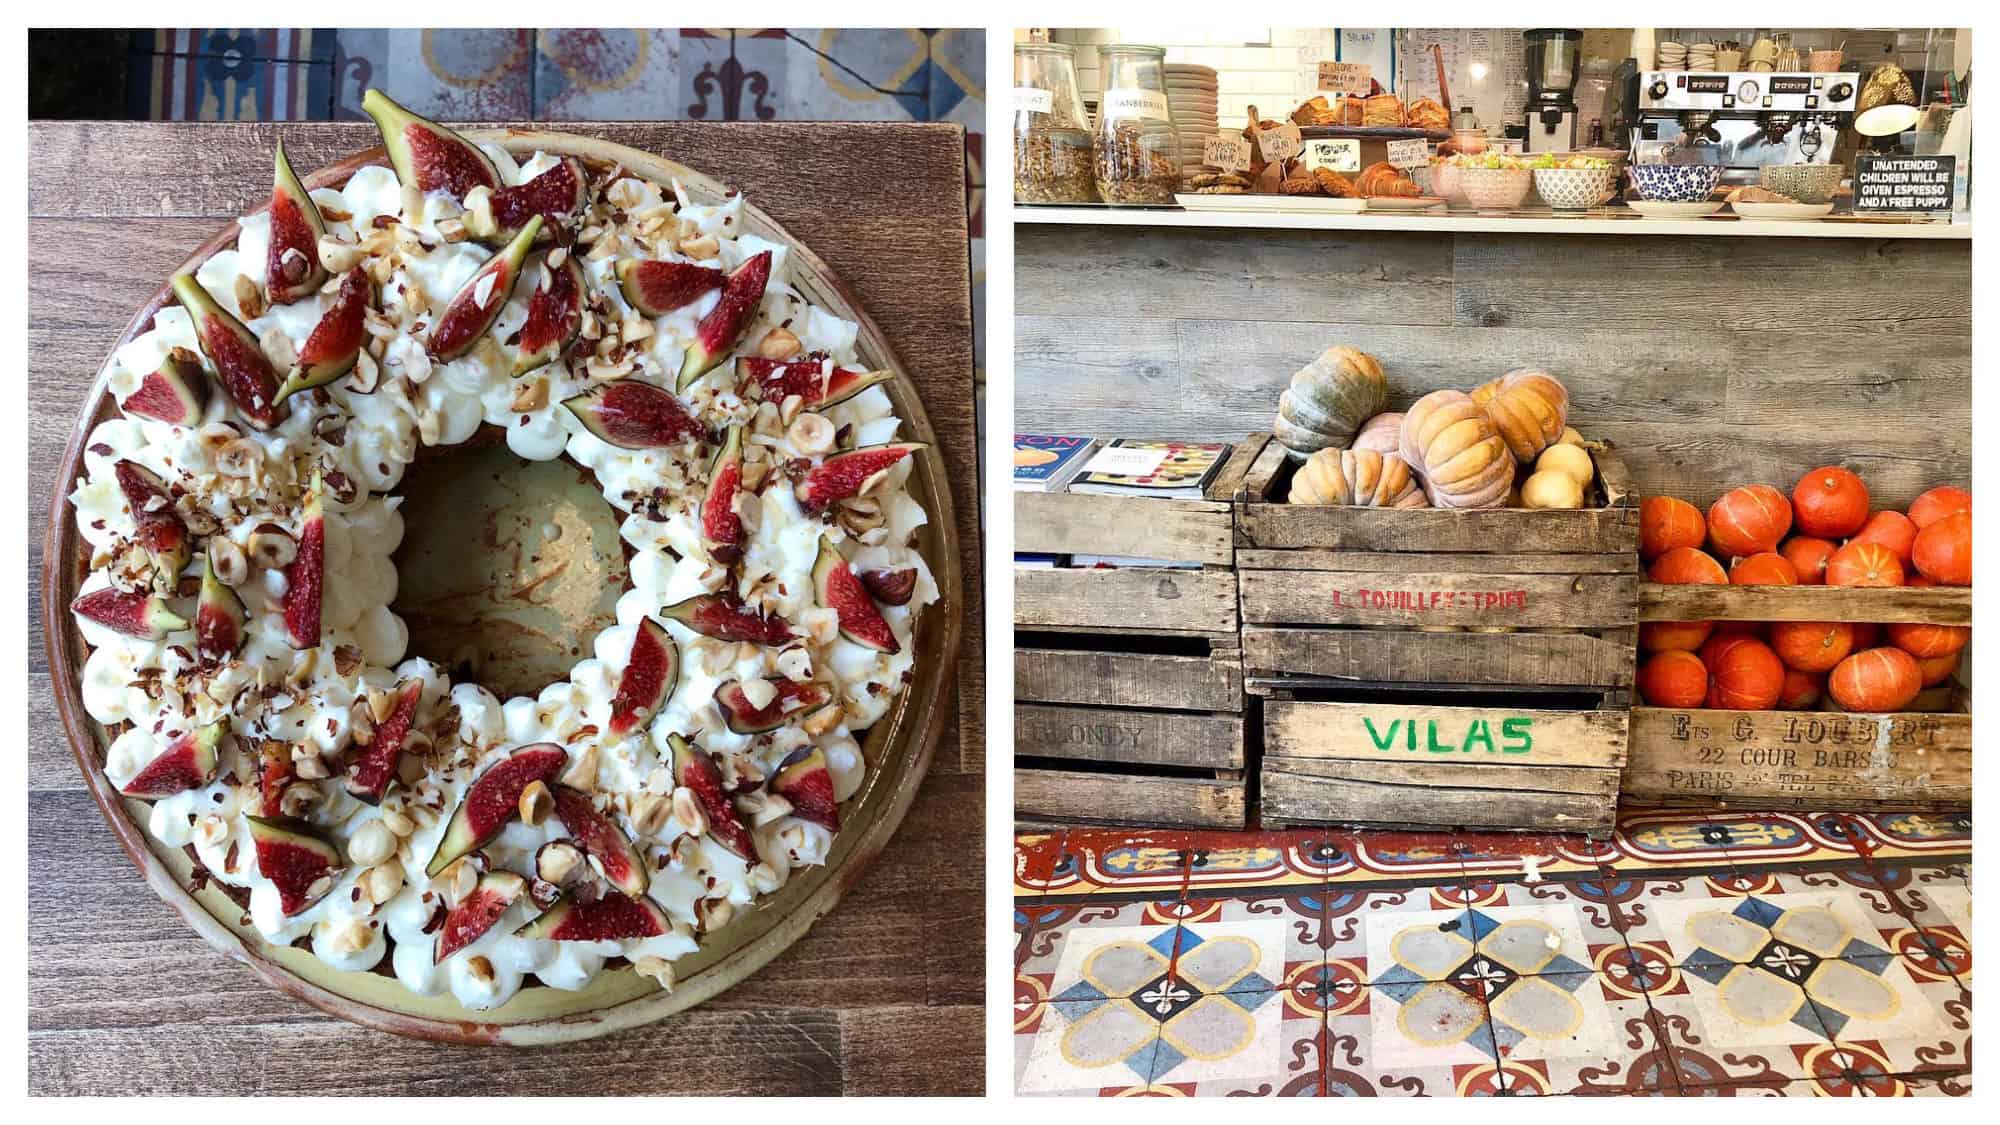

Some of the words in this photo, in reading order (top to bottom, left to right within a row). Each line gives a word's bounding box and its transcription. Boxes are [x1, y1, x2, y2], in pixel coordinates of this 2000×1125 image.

[1872, 160, 1938, 171] UNATTENDED
[1860, 172, 1909, 183] CHILDREN
[1911, 172, 1934, 183] WILL
[1935, 172, 1949, 183] BE
[1862, 184, 1892, 195] GIVEN
[1894, 184, 1945, 195] ESPRESSO
[1859, 197, 1879, 207] AND
[1880, 197, 1888, 207] A
[1889, 197, 1914, 207] FREE
[1915, 197, 1948, 207] PUPPY
[1362, 716, 1534, 753] VILAS
[1698, 746, 1726, 765] 22
[1740, 748, 1797, 767] COUR
[1665, 769, 1734, 790] PARIS
